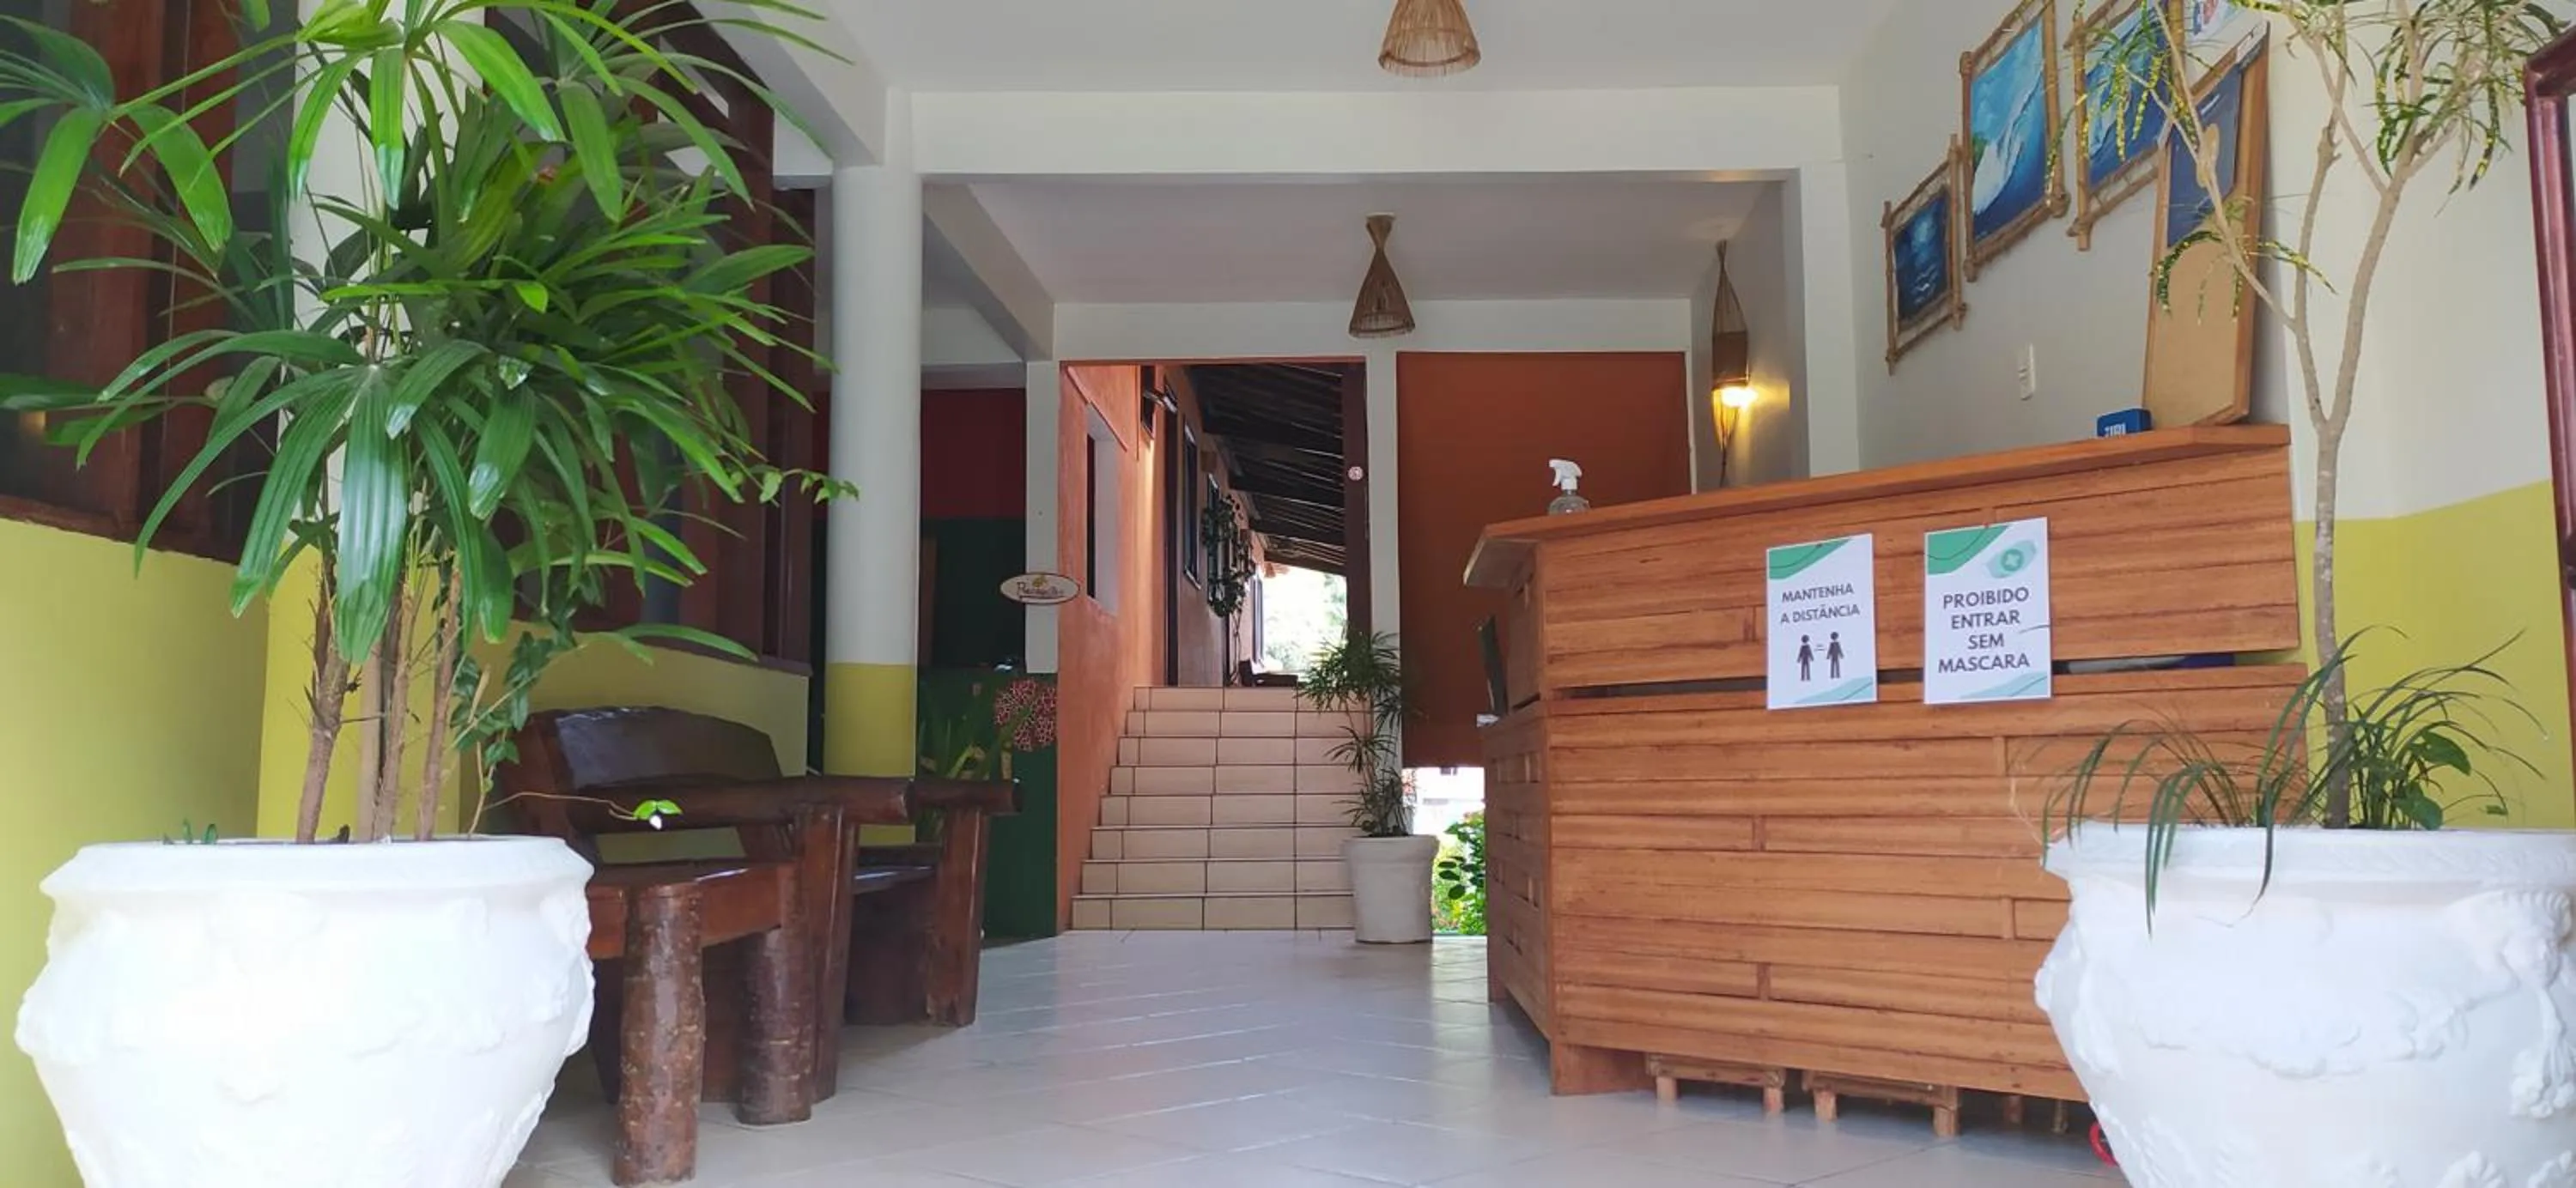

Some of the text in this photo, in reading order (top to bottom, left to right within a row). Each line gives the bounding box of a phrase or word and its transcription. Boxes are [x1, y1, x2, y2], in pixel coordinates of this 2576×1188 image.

[1782, 583, 1854, 603] MANTENHA
[1943, 586, 2029, 609] PROIBIDO
[1781, 613, 1789, 624] A
[1951, 609, 2020, 630] ENTRAR
[1967, 633, 2005, 650] SEM
[1938, 652, 2030, 673] MASCARA
